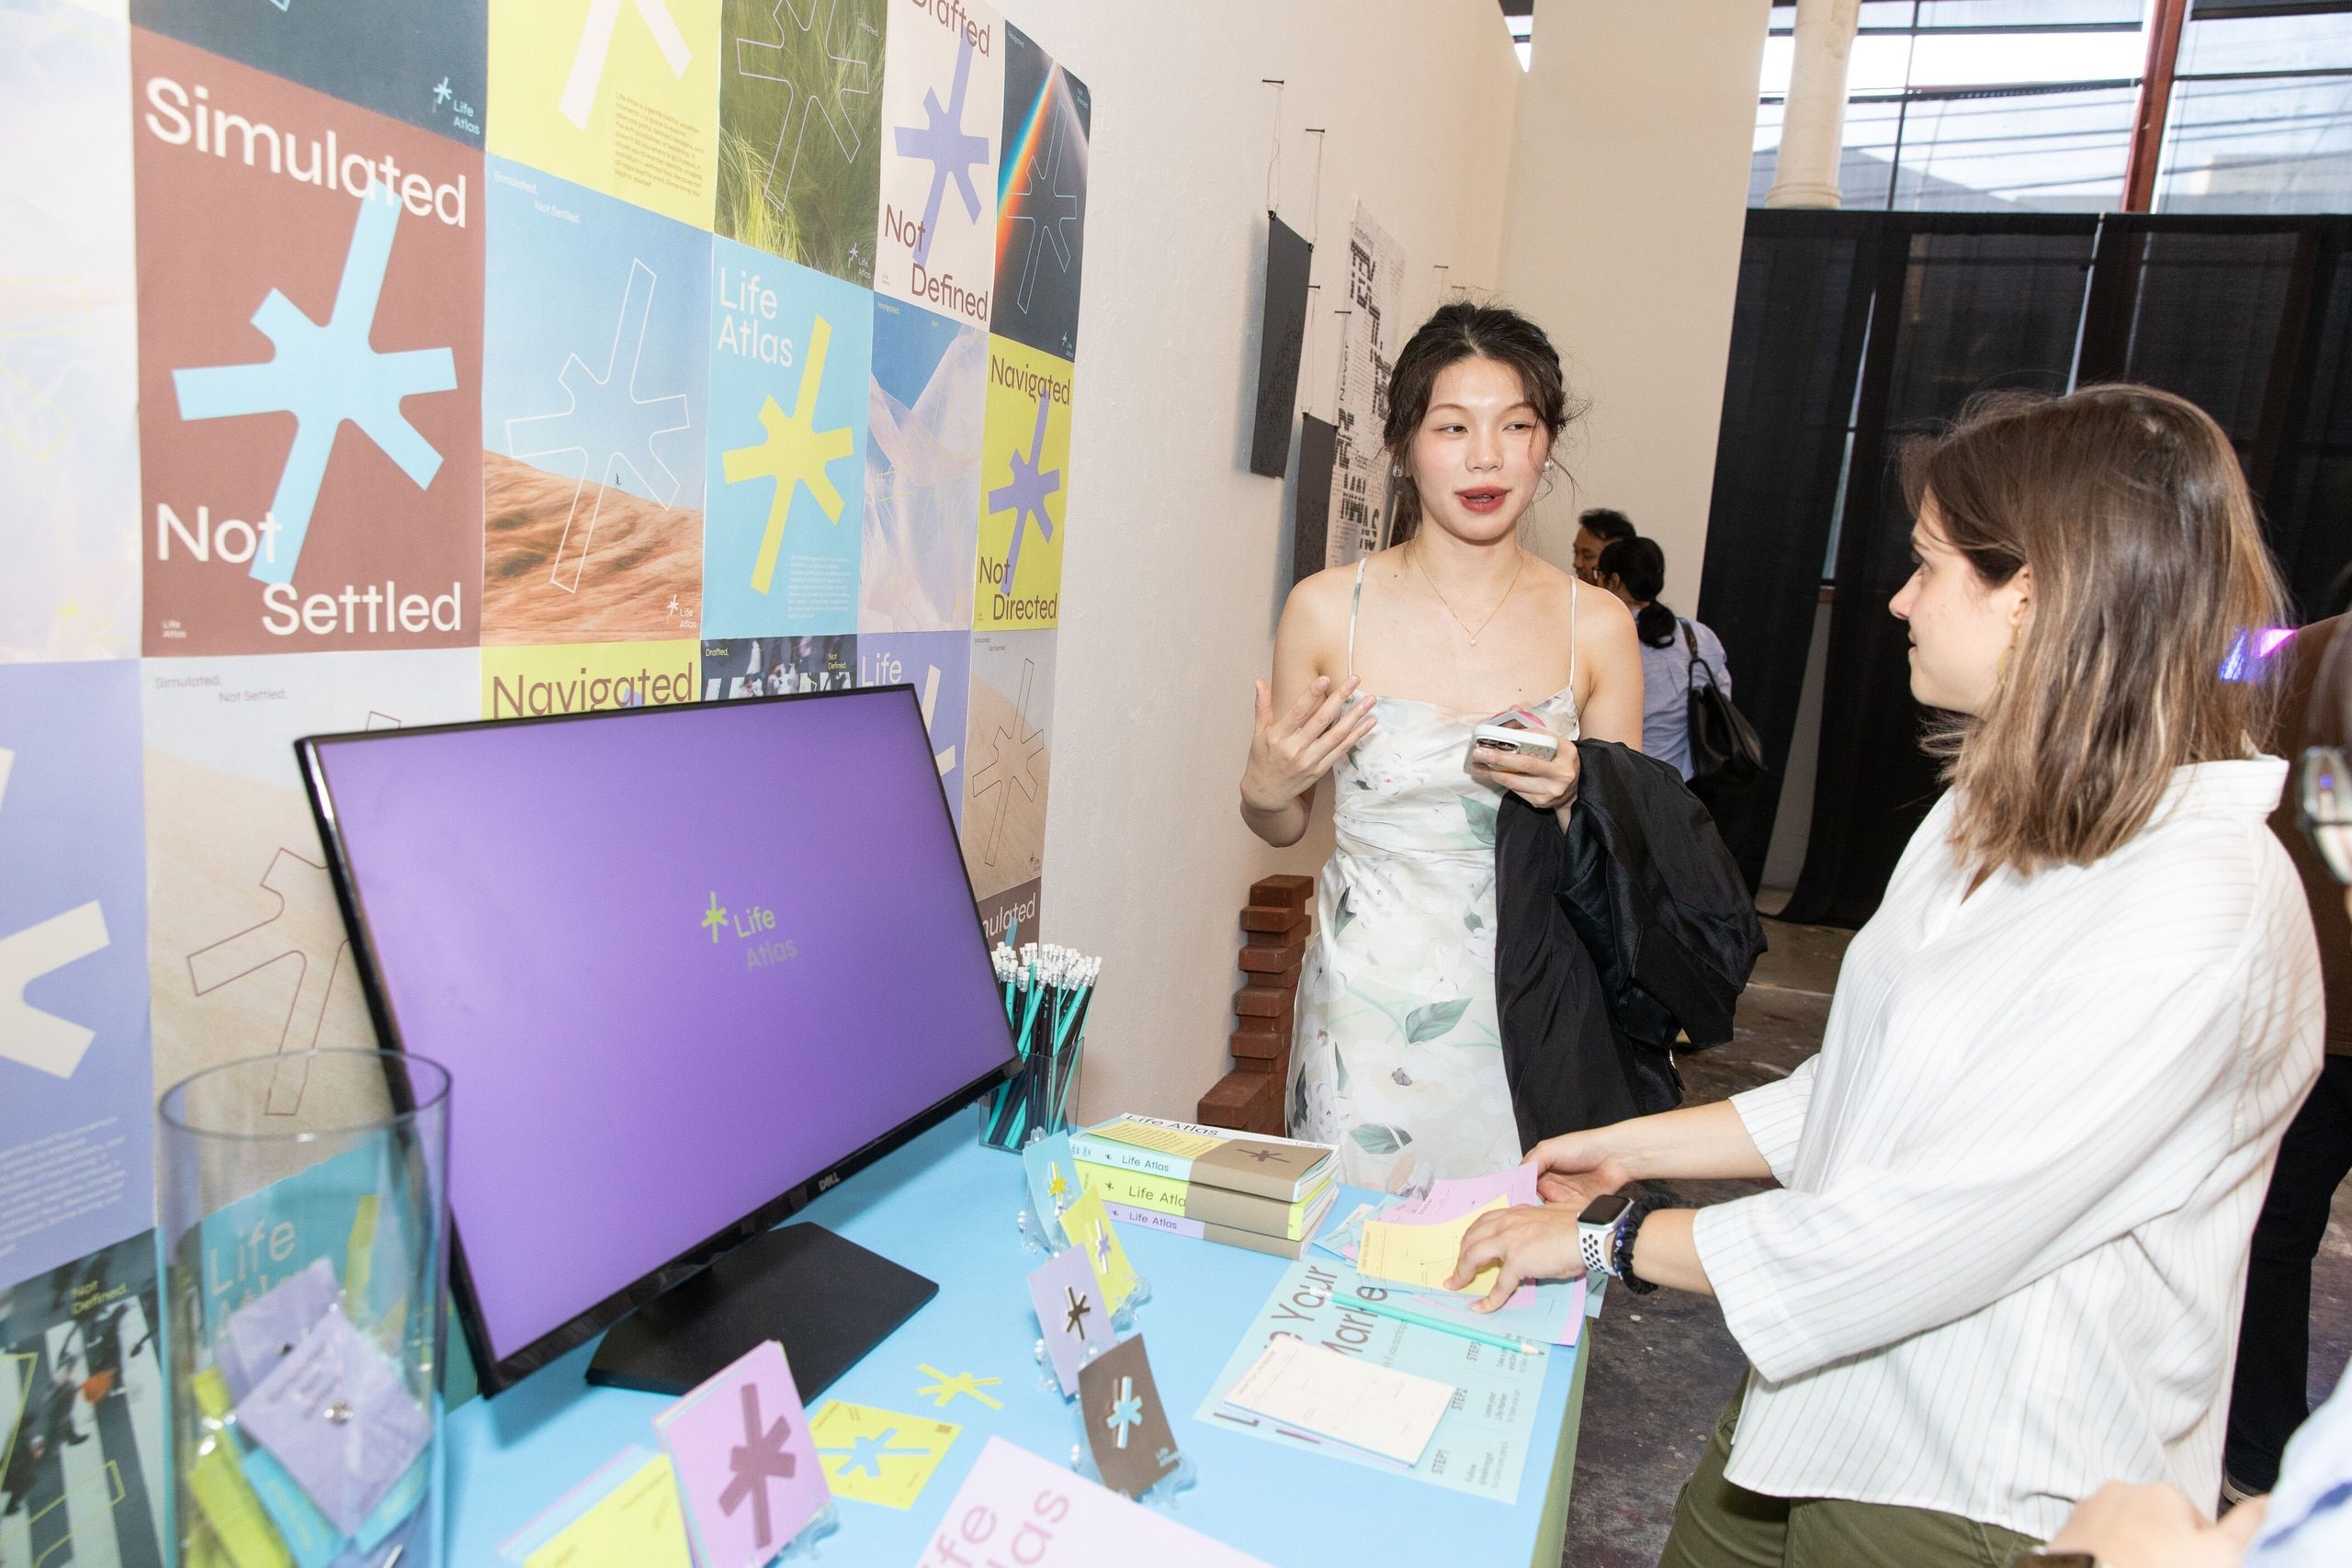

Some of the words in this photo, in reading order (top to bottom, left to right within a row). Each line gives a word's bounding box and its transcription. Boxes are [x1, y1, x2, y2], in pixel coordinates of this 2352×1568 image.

[453, 99, 474, 117] Life
[453, 116, 481, 135] Atlas
[145, 76, 467, 229] Simulated
[885, 204, 925, 252] Not
[720, 265, 777, 320] Life
[911, 262, 989, 321] Defined
[718, 313, 794, 368] Atlas
[991, 354, 1071, 406] Navigated
[156, 502, 283, 564] Not
[979, 556, 1011, 584] Not
[262, 581, 461, 636] Settled
[680, 608, 694, 618] Life
[992, 592, 1058, 621] Directed
[705, 648, 729, 658] Drafted,
[828, 653, 838, 661] Not
[861, 652, 902, 686] Life
[219, 691, 242, 704] Not
[243, 688, 288, 703] Settled.
[492, 661, 693, 719] Navigated
[733, 906, 776, 938] Life
[747, 939, 797, 971] Atlas
[1125, 1114, 1164, 1126] Life
[1167, 1122, 1220, 1137] Atlas
[1122, 1155, 1141, 1168] Life
[1144, 1159, 1170, 1173] Atlas
[818, 1171, 841, 1191] DELL
[1128, 1185, 1154, 1201] Life
[1159, 1192, 1187, 1208] Atla
[1129, 1212, 1148, 1224] Life
[1152, 1217, 1178, 1231] Atlas
[209, 1219, 296, 1298] Life
[1271, 1265, 1338, 1322] Your
[1452, 1387, 1468, 1411] STEP2
[1431, 1449, 1450, 1475] STEP1
